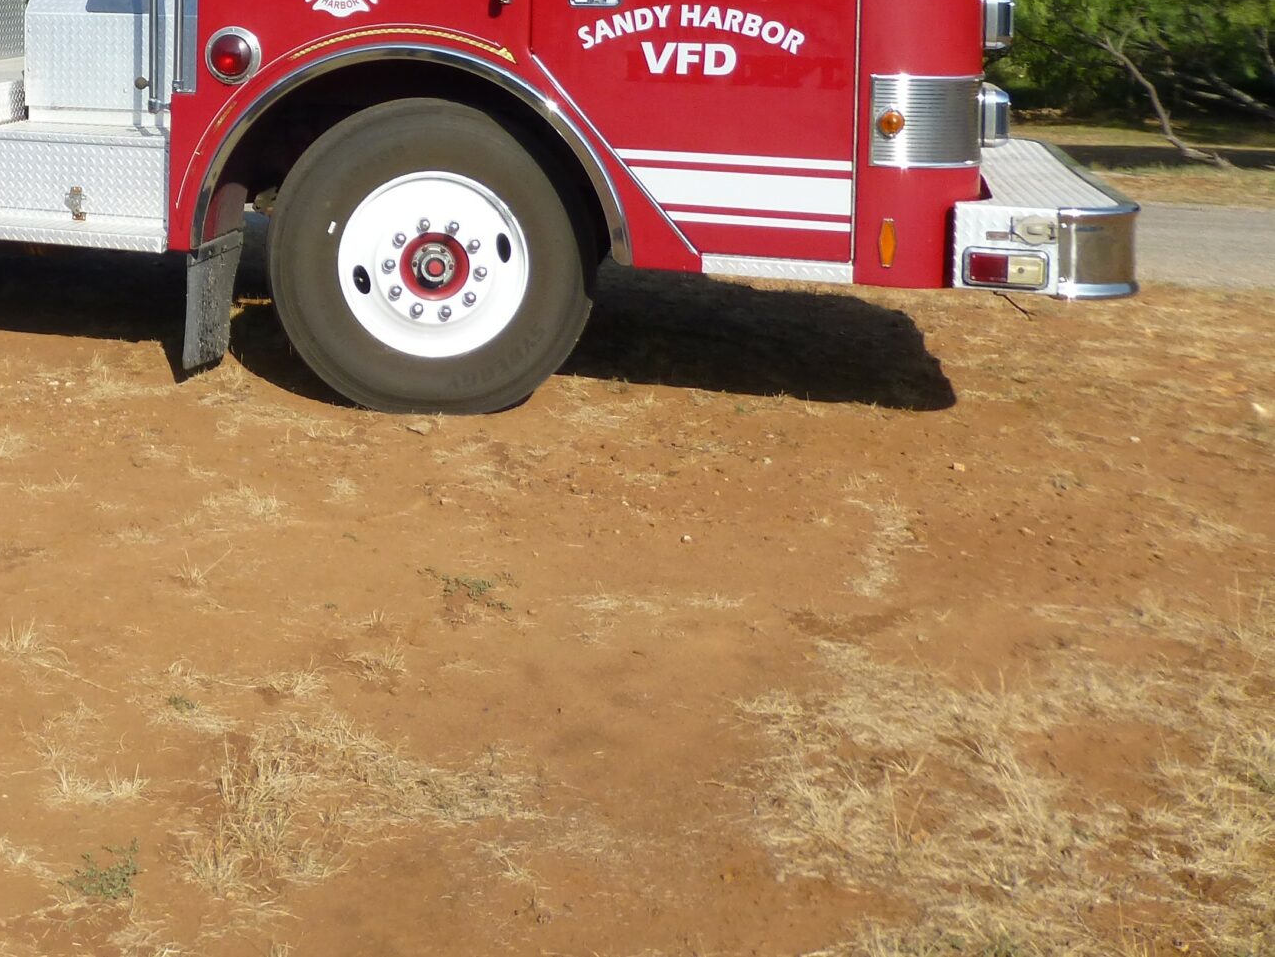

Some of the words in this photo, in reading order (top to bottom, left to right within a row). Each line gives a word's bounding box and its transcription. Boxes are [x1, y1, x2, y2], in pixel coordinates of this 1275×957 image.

[578, 5, 671, 49] SANDY
[680, 5, 805, 55] HARBOR
[641, 42, 737, 75] VFD
